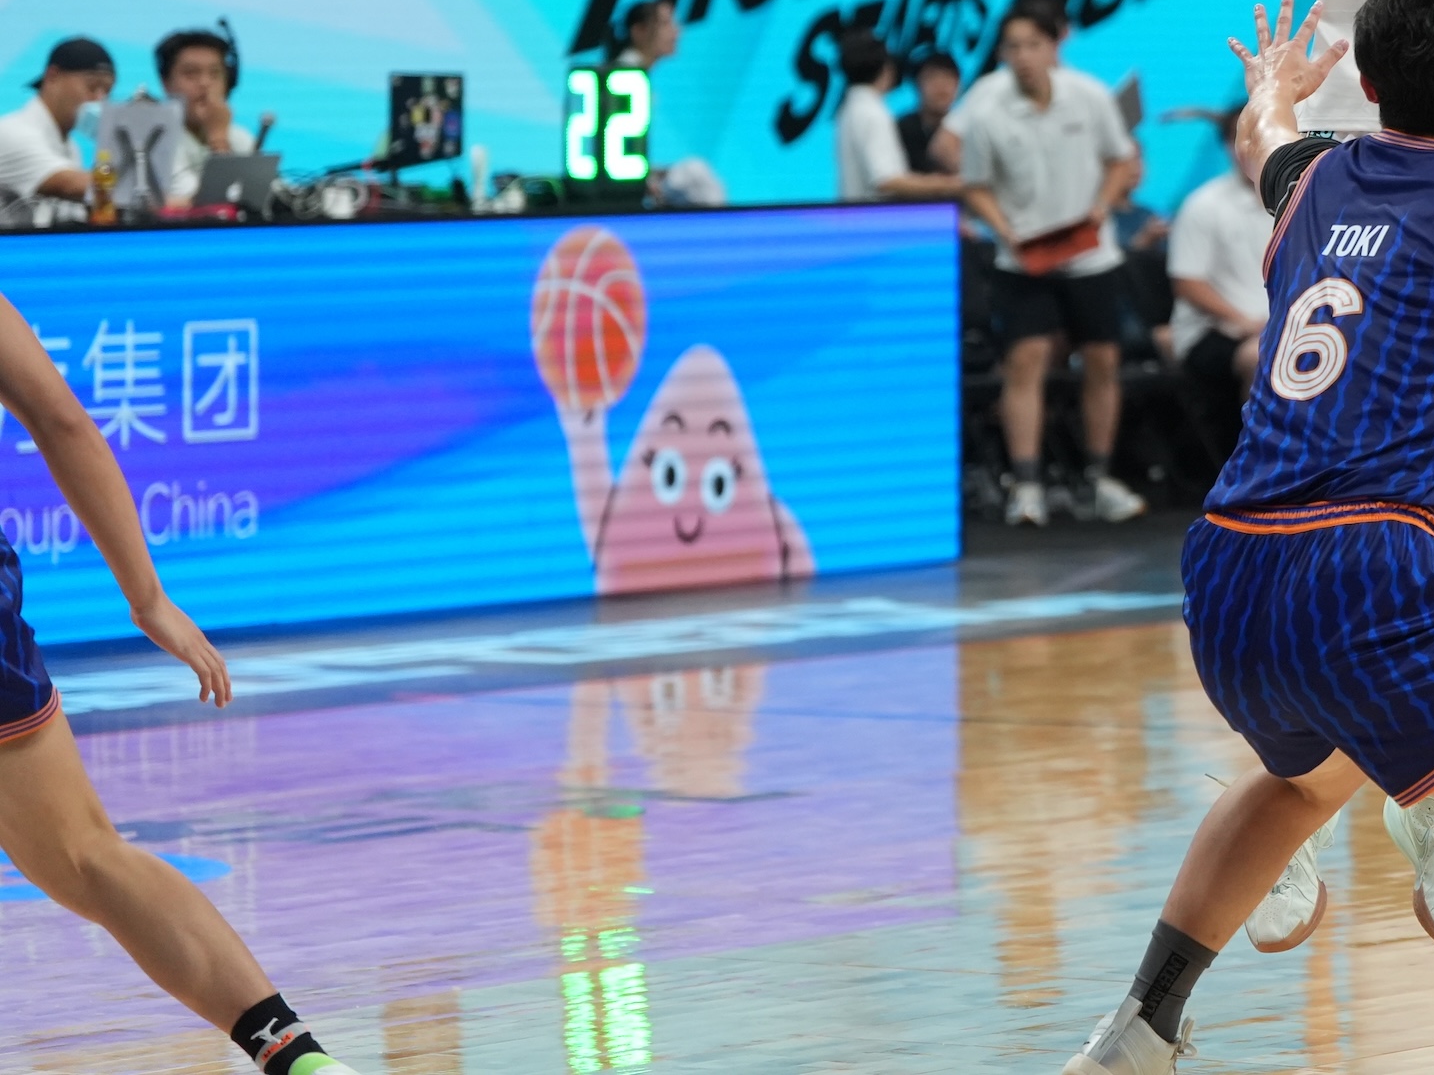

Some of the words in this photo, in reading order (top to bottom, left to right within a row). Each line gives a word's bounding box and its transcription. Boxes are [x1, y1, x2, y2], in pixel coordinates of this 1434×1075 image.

[566, 69, 651, 180] 22
[1321, 224, 1390, 257] TOKI
[1271, 277, 1364, 402] 6
[141, 479, 259, 546] China
